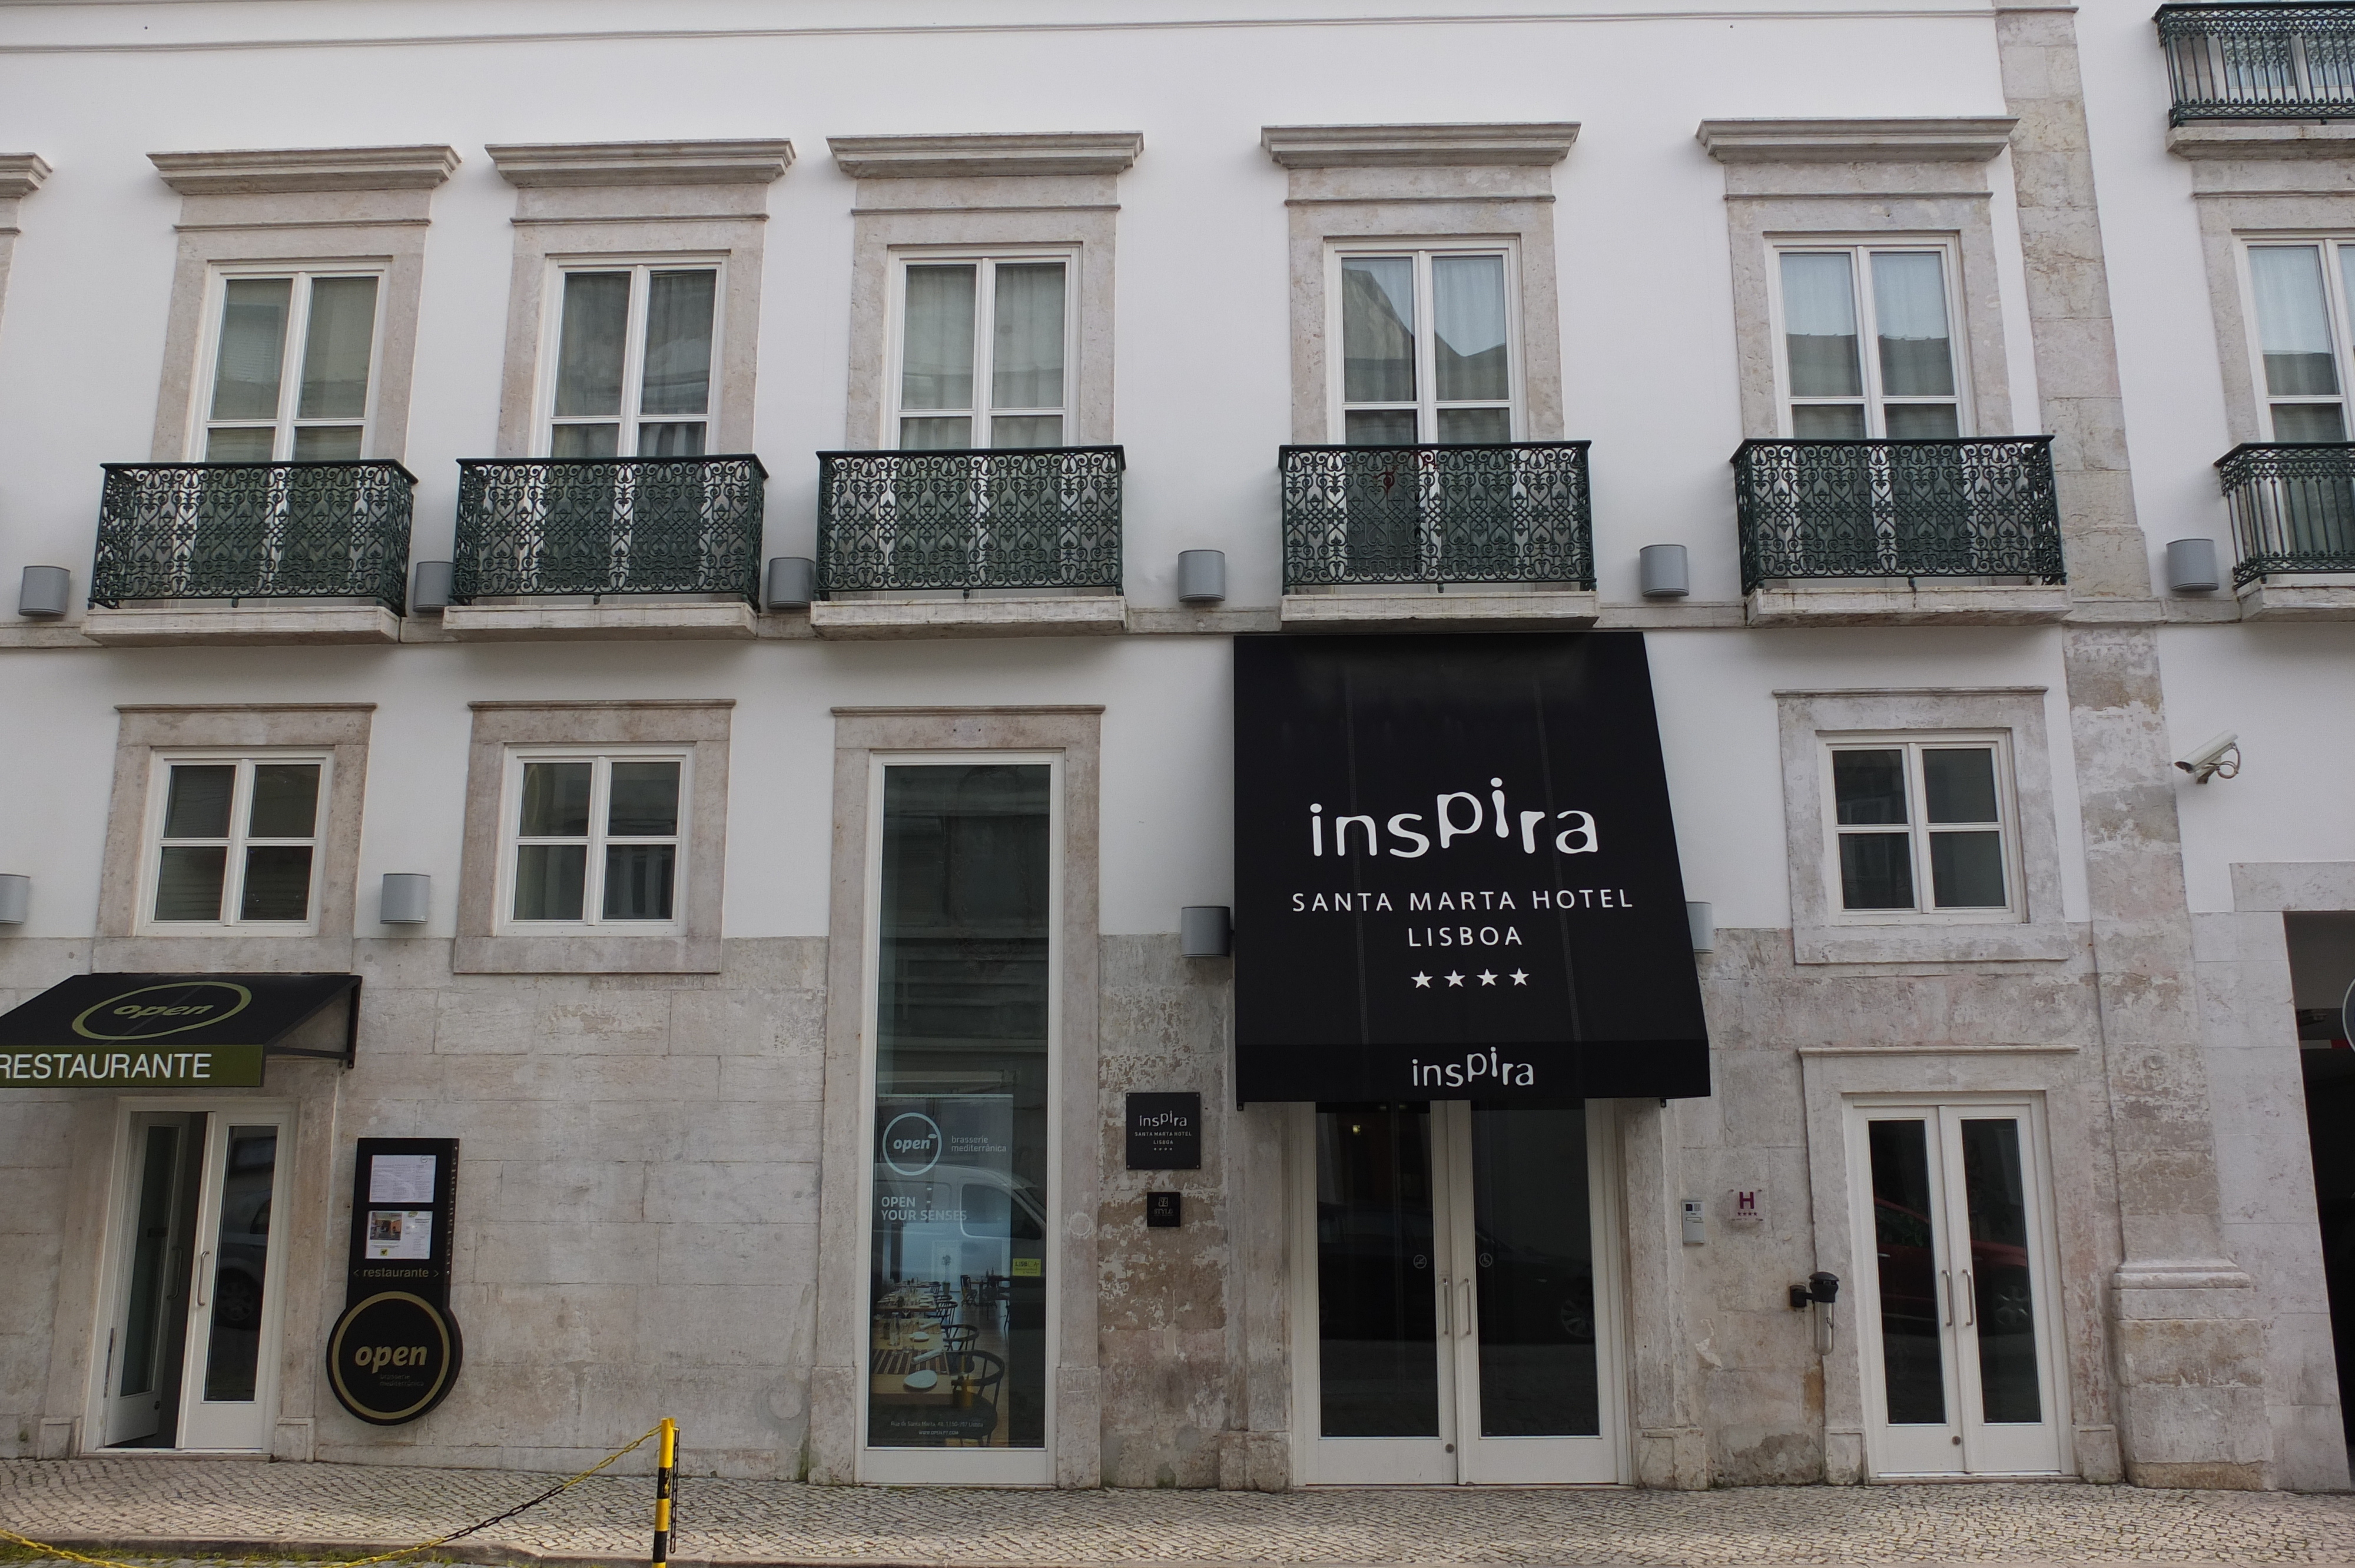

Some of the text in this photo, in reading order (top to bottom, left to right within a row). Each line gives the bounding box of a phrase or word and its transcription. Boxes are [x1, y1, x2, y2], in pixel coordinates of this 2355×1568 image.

[1310, 778, 1598, 858] inspira
[1292, 889, 1633, 912] SANTA MARTA HOTEL
[1408, 926, 1523, 947] LISBOA
[113, 1004, 214, 1019] open
[0, 1053, 213, 1079] RESTAURANTE
[1412, 1046, 1534, 1087] inspira
[1139, 1110, 1188, 1127] inspira
[893, 1139, 931, 1153] open
[951, 1135, 989, 1144] brasserie
[951, 1143, 1007, 1152] mediterrânica
[881, 1197, 916, 1207] OPEN
[1739, 1191, 1754, 1210] H
[881, 1210, 967, 1221] YOUR SENSES
[363, 1268, 429, 1277] restaurante
[355, 1346, 427, 1374] open
